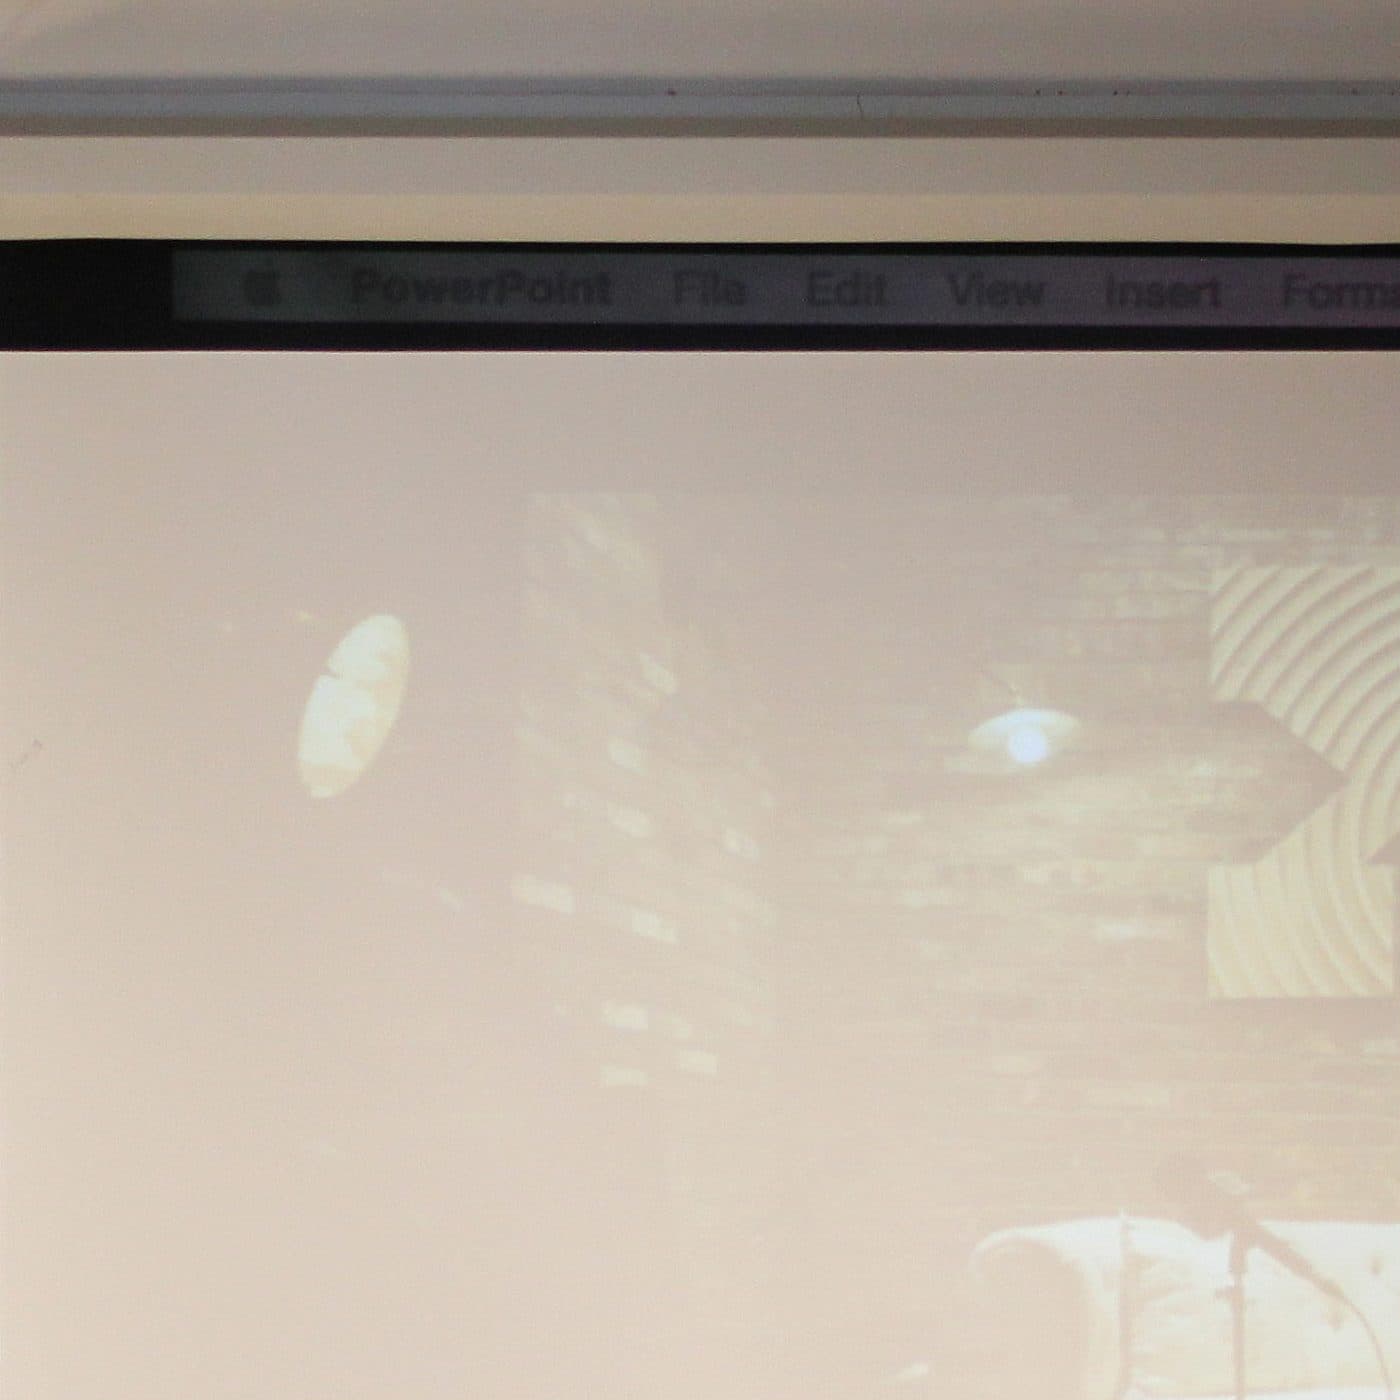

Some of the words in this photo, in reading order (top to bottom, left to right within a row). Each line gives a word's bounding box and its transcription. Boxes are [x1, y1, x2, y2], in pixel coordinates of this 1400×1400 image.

[350, 268, 613, 306] PowerPoint
[674, 269, 746, 307] File
[806, 268, 889, 307] Edit
[947, 269, 1044, 308] View
[1105, 272, 1223, 310] Insert
